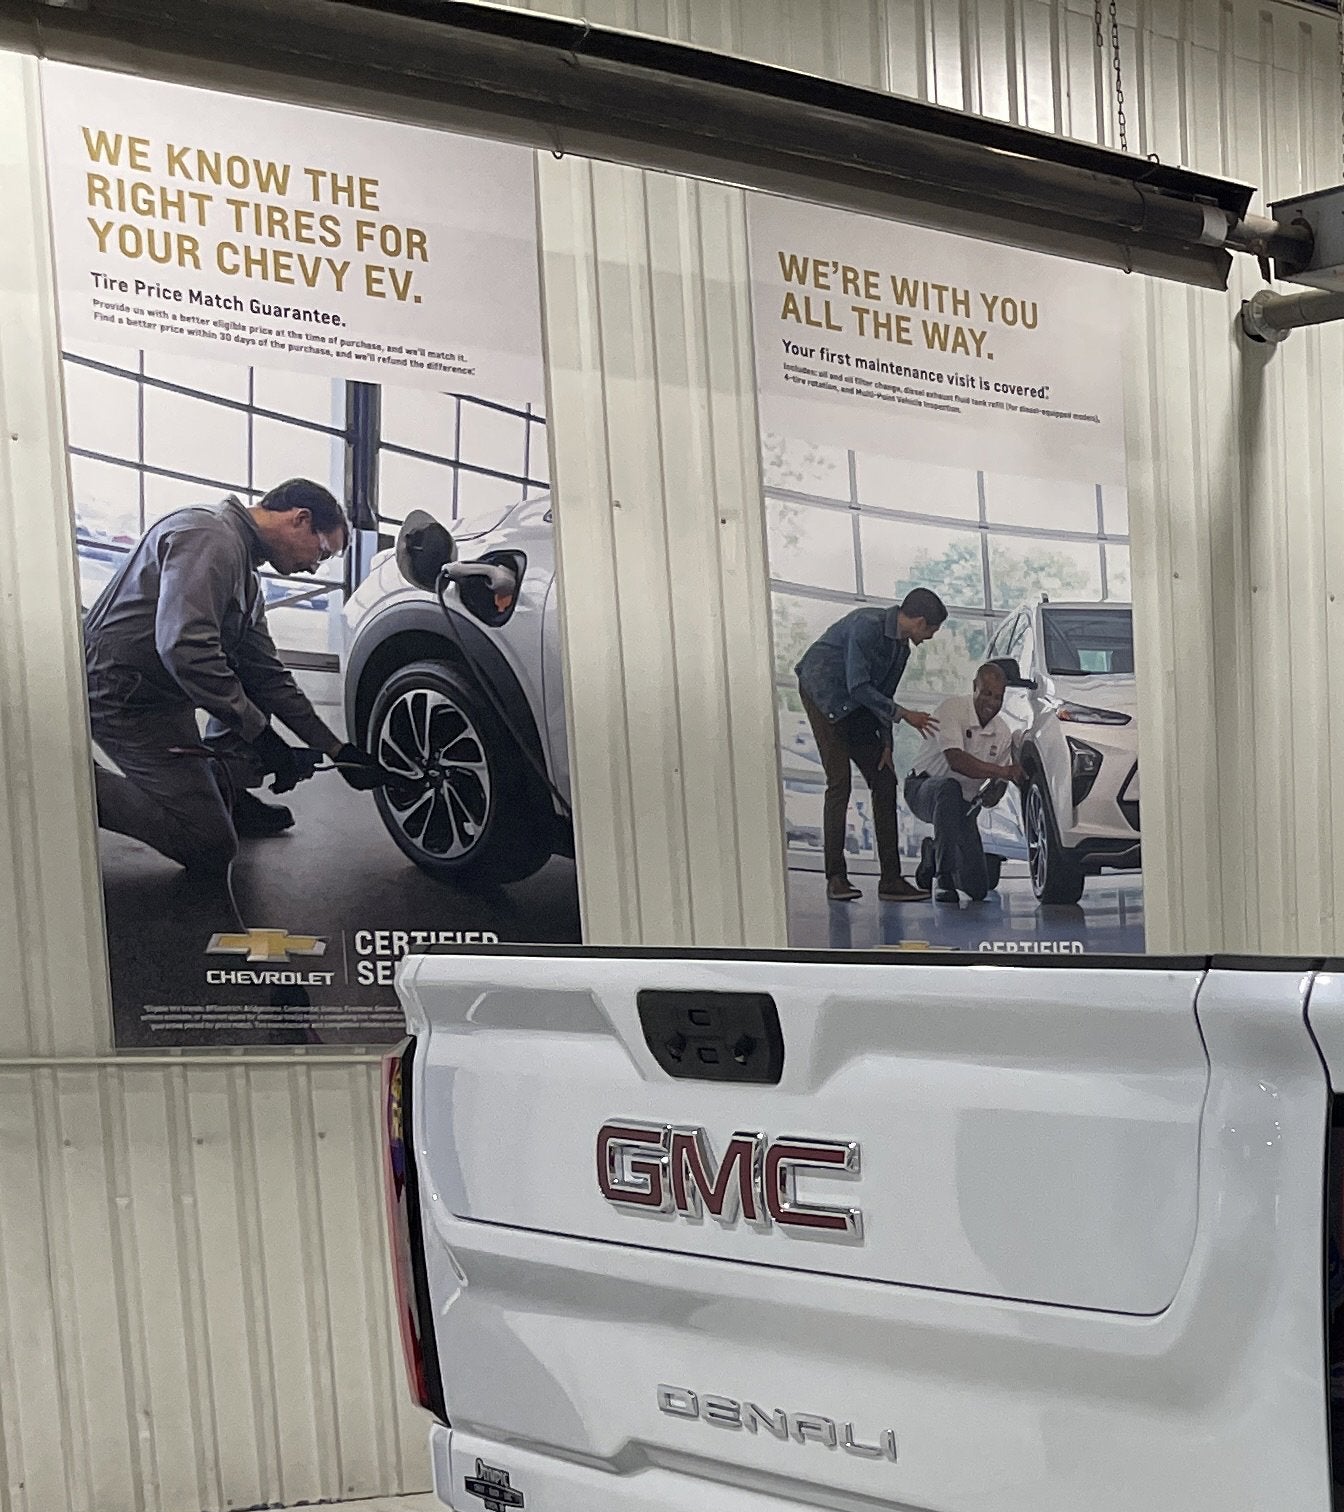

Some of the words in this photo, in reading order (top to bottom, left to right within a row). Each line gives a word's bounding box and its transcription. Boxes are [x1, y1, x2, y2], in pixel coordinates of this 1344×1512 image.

[82, 126, 150, 172] WE
[167, 144, 290, 195] KNOW
[304, 168, 379, 212] THE
[86, 173, 212, 226] RIGHT
[227, 199, 341, 248] TIRES
[357, 222, 428, 262] FOR
[88, 217, 201, 269] YOUR
[216, 240, 350, 292] CHEVY
[365, 265, 422, 303] EV.
[778, 251, 881, 300] WE'RE
[890, 275, 971, 318] WITH
[980, 292, 1038, 330] YOU
[90, 272, 128, 292] Tire
[134, 280, 182, 301] Price
[189, 289, 243, 312] Match
[250, 299, 346, 328] Guarantee.
[93, 298, 130, 312] Provide
[134, 306, 144, 315] us
[148, 308, 168, 320] with
[180, 314, 210, 326] better
[250, 326, 272, 337] price
[276, 328, 285, 338] at
[288, 330, 302, 340] the
[306, 333, 326, 344] time
[328, 336, 337, 344] of
[387, 345, 403, 354] and
[428, 350, 456, 361] match
[781, 292, 842, 332] ALL
[852, 306, 912, 346] THE
[921, 320, 994, 360] WAY.
[94, 312, 114, 322] Find
[127, 317, 157, 330] better
[160, 324, 184, 336] price
[187, 328, 217, 340] within
[220, 332, 231, 342] 30
[234, 334, 256, 346] days
[258, 338, 268, 347] of
[270, 340, 285, 350] the
[336, 350, 352, 359] and
[378, 356, 408, 367] refund
[410, 360, 424, 369] the
[782, 339, 815, 359] Your
[820, 348, 851, 367] first
[856, 356, 944, 383] maintenance
[947, 372, 975, 388] visit
[979, 376, 990, 391] is
[206, 970, 334, 986] CHEVROLET
[597, 1117, 864, 1240] GMC
[656, 1383, 898, 1464] DENALI
